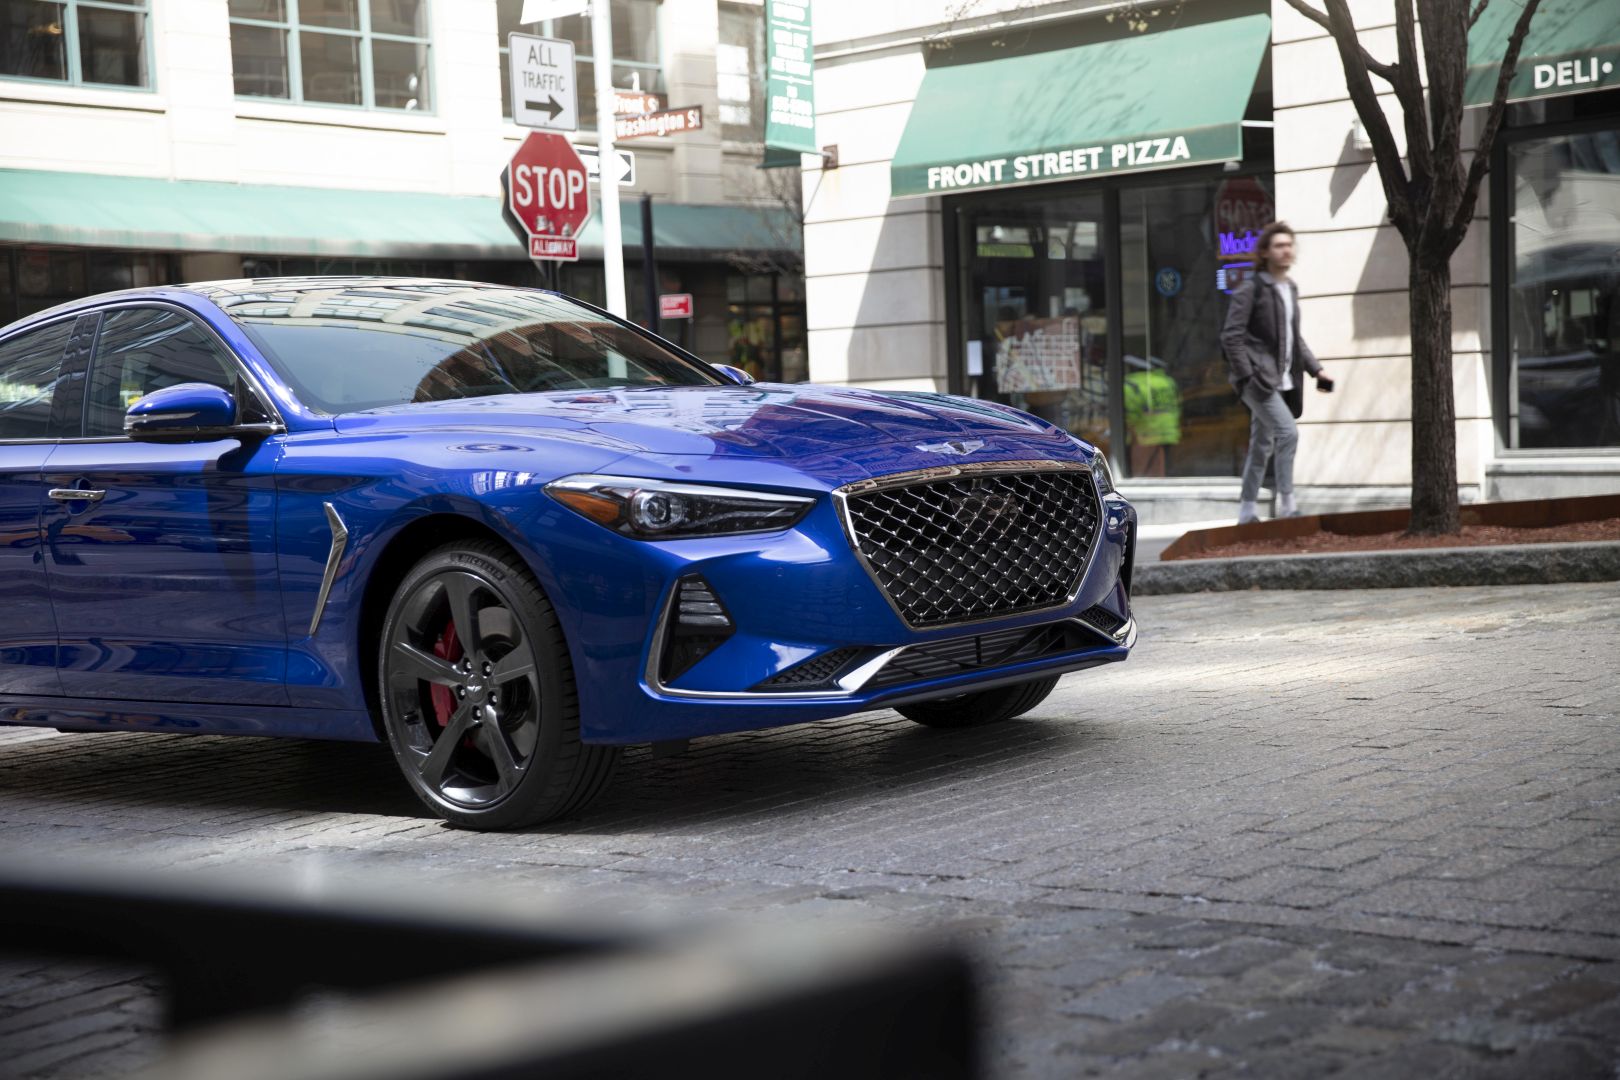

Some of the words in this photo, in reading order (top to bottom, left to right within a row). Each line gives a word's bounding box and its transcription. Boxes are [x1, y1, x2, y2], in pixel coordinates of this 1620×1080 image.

[528, 45, 557, 67] ALL
[523, 71, 565, 92] TRAFFIC
[1534, 57, 1598, 89] DELI
[616, 113, 684, 136] Washington
[928, 159, 1006, 189] FRONT
[1014, 147, 1103, 179] STREET
[1111, 136, 1190, 167] PIZZA
[515, 164, 584, 210] STOP
